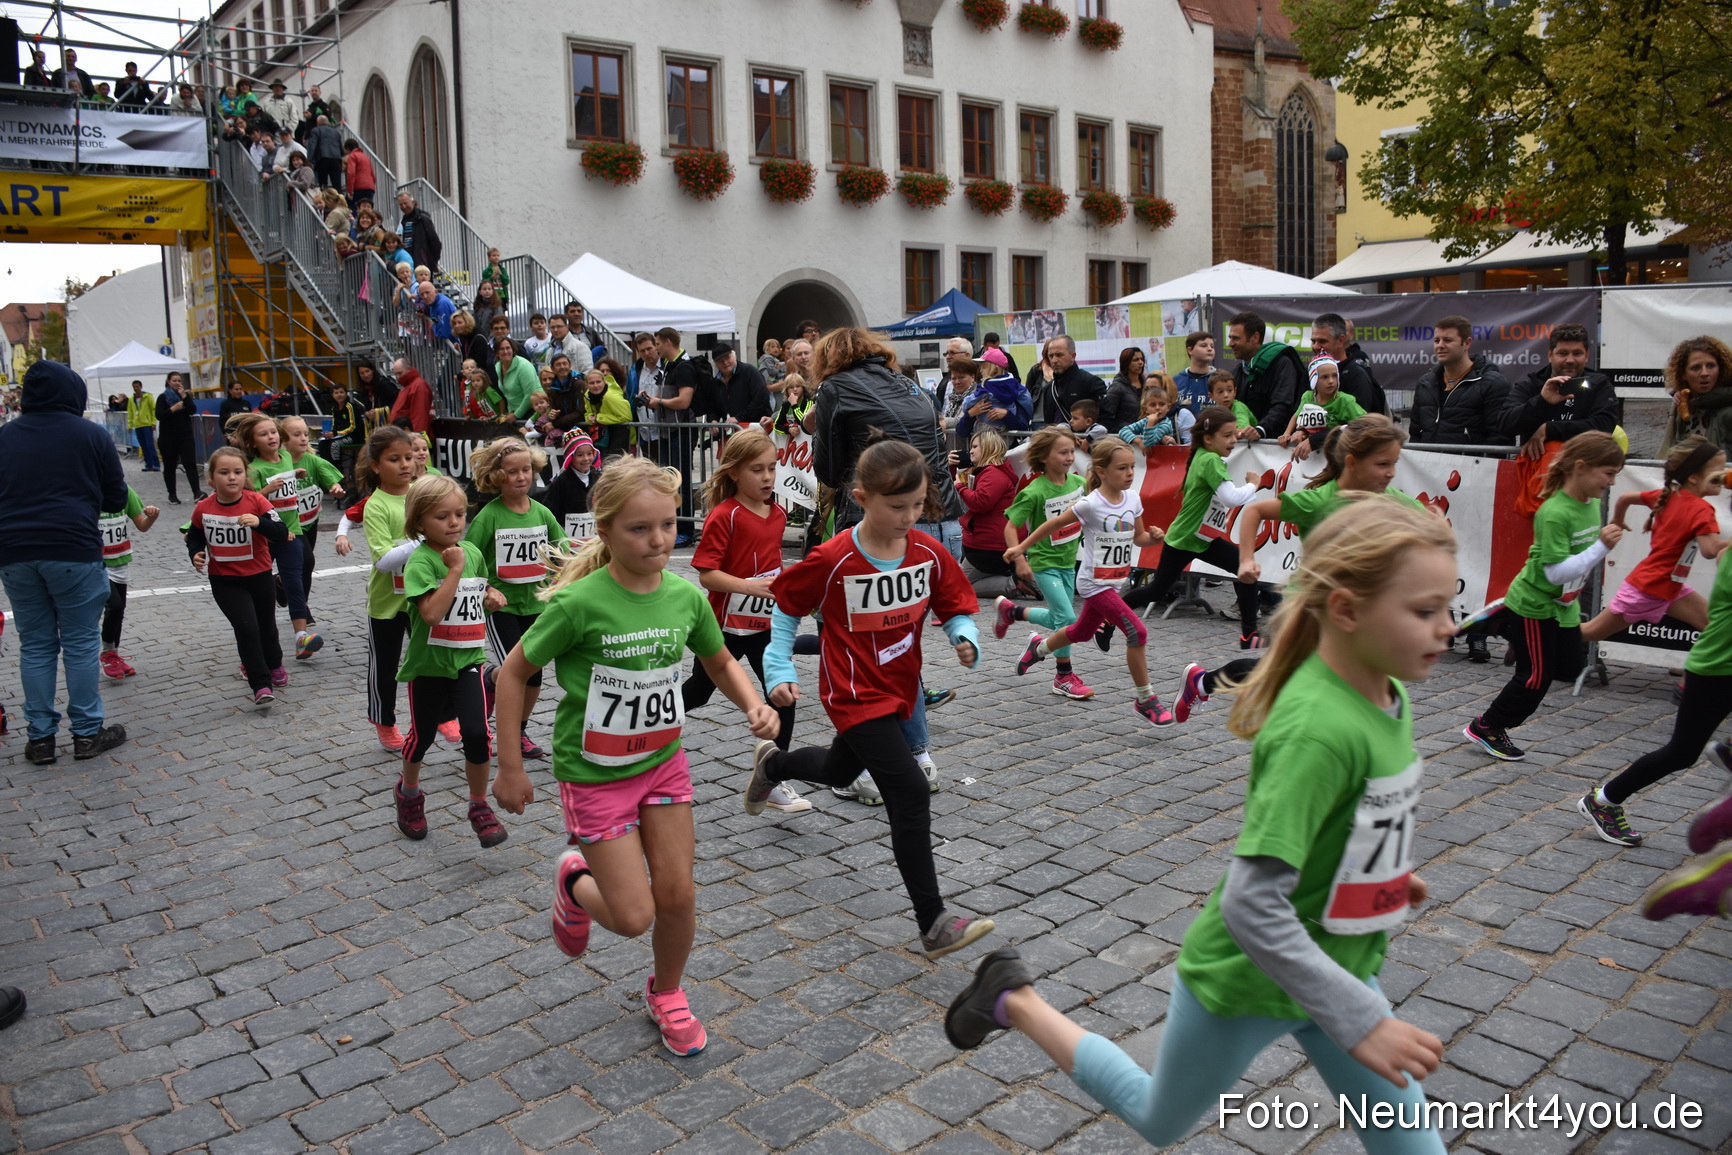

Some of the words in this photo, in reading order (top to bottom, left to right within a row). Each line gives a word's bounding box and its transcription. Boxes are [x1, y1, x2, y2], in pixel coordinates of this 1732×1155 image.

[8, 136, 38, 145] MEHR
[1354, 326, 1399, 341] FFICE
[1405, 326, 1494, 340] INDRY
[1501, 324, 1572, 340] LOUN
[1299, 412, 1325, 427] 7069
[300, 491, 321, 511] 127
[1206, 508, 1226, 530] 740
[207, 526, 247, 544] 7500
[855, 567, 925, 609] 7003
[737, 594, 776, 615] 709
[748, 618, 767, 629] Lisa
[882, 612, 911, 627] Anna
[601, 627, 670, 645] Neumarkter
[1628, 623, 1702, 644] Leistung
[602, 641, 660, 659] Stadtlauf
[594, 674, 630, 690] PARTL
[633, 677, 672, 690] Neumarkt
[601, 688, 677, 731] 7199
[627, 737, 647, 753] Lili
